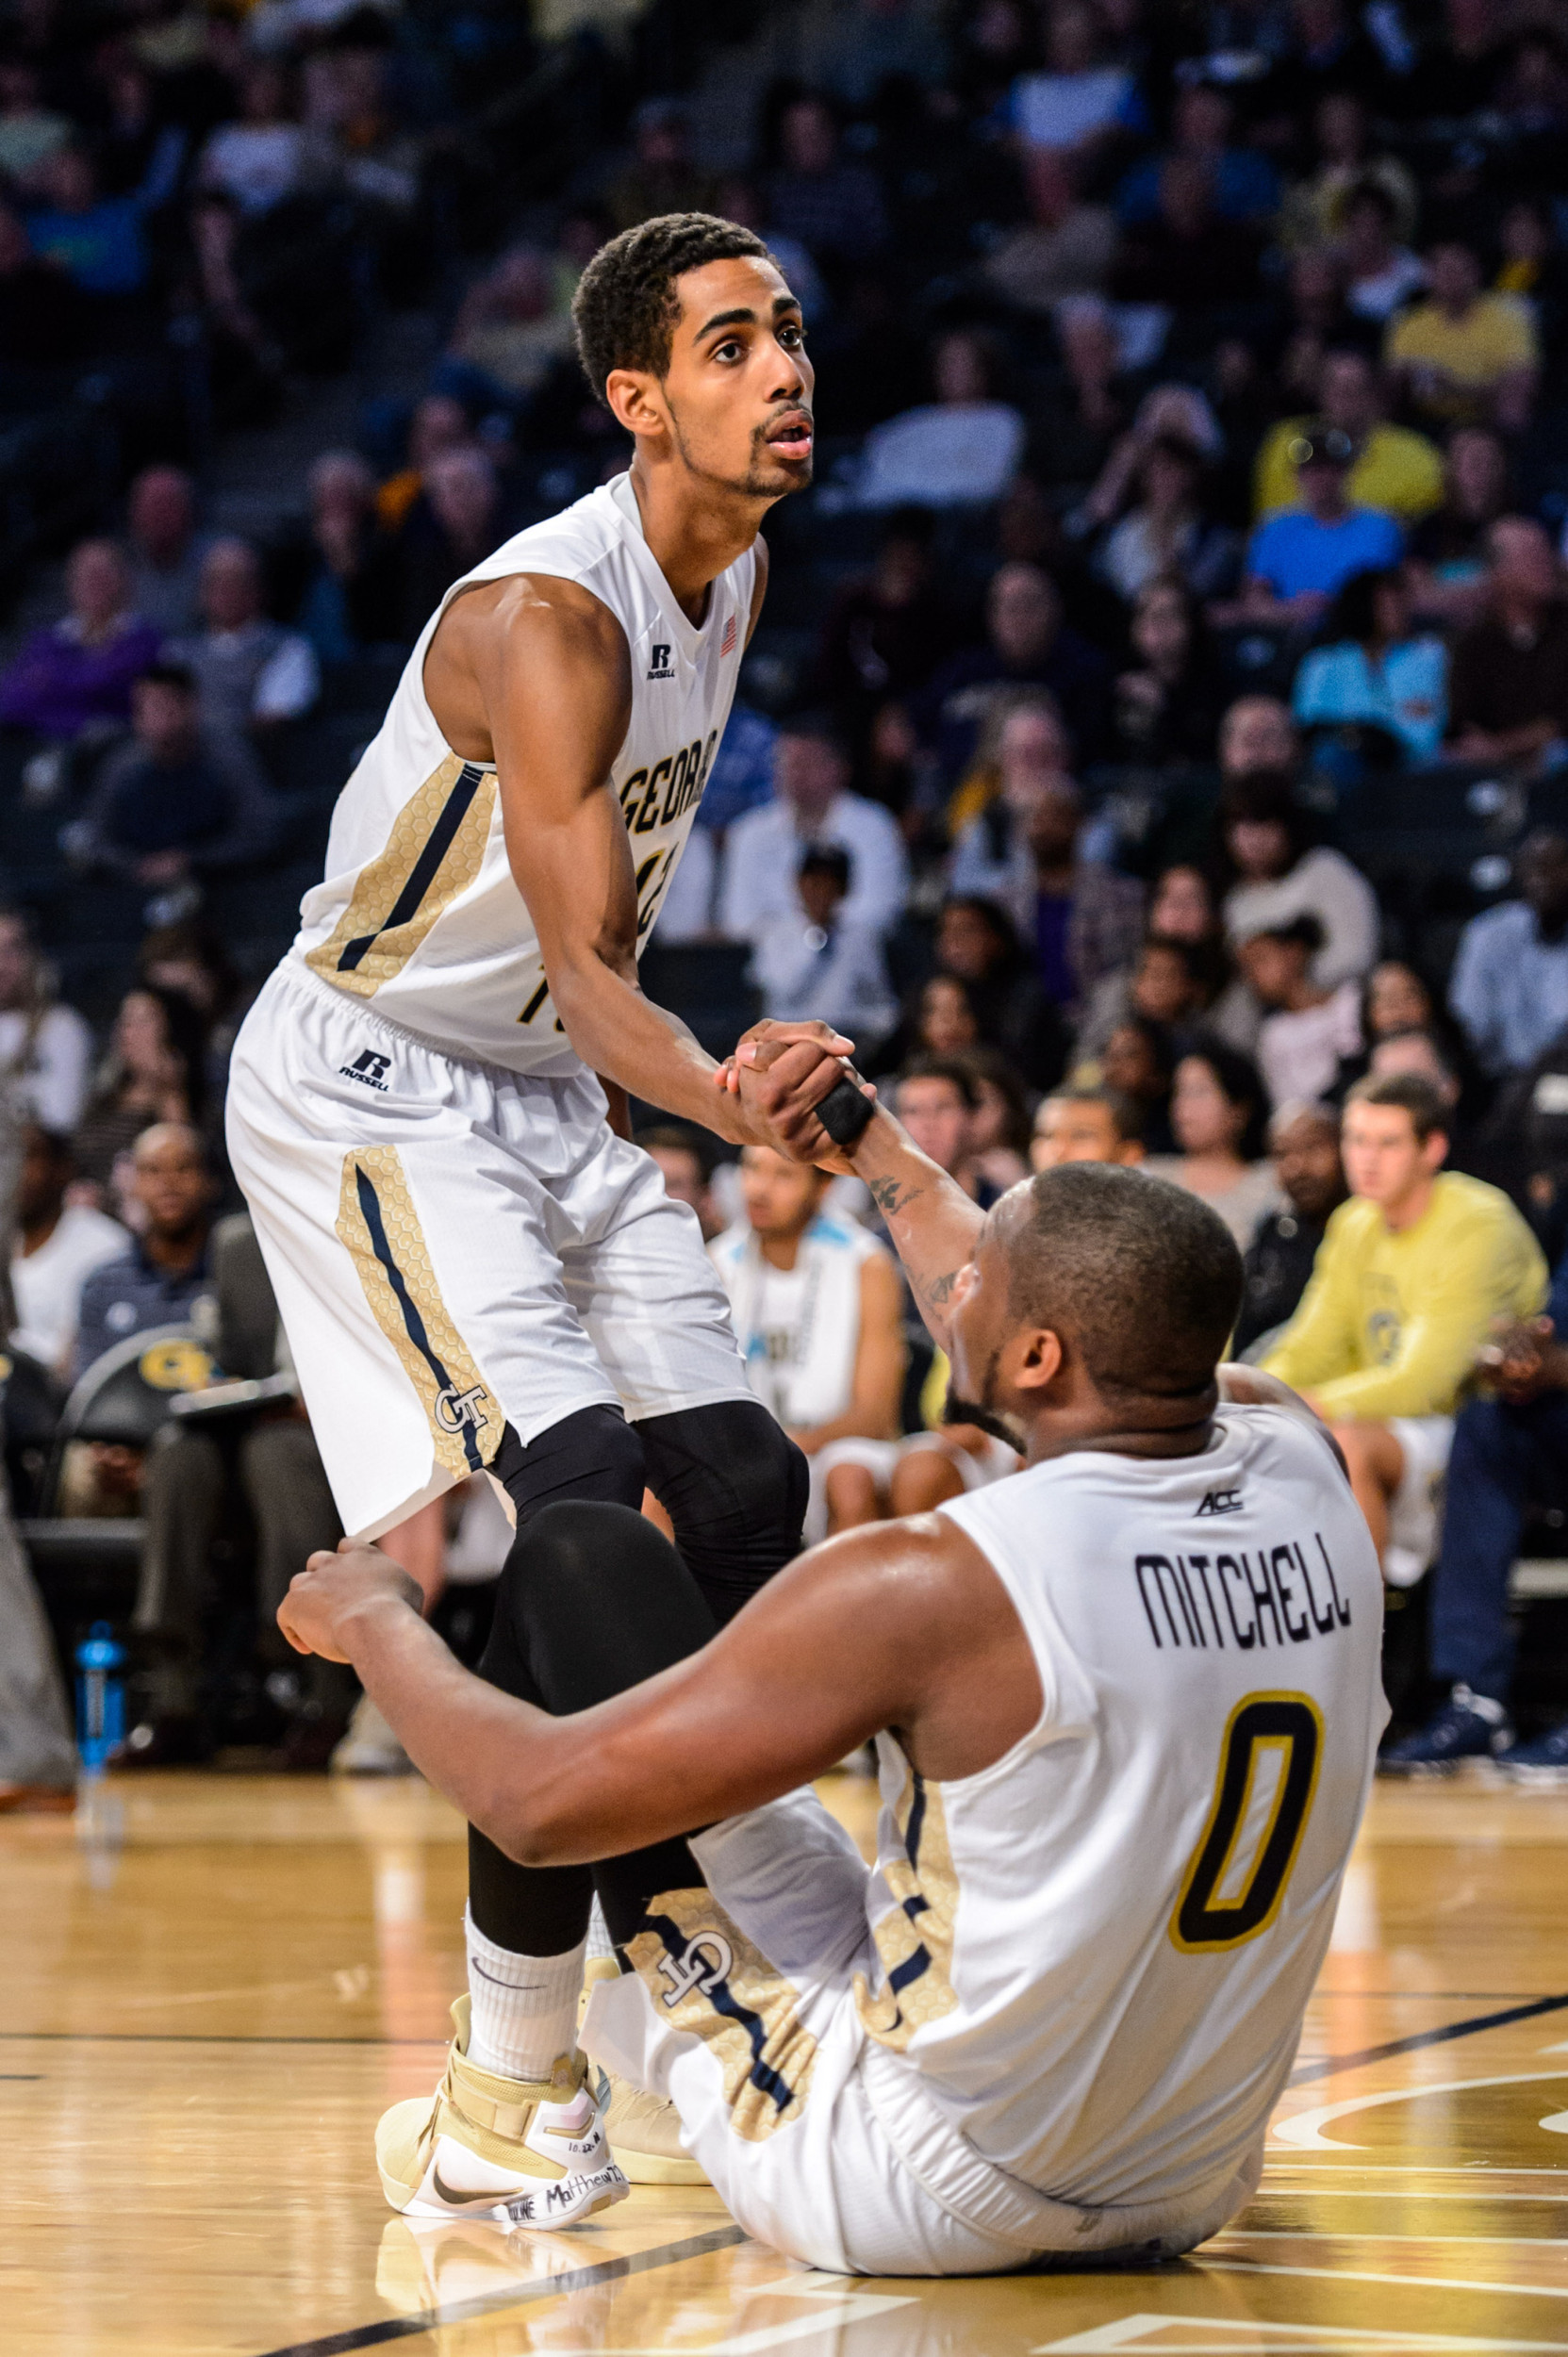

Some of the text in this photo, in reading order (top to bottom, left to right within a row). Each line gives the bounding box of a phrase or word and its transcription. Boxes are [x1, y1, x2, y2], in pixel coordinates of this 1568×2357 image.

[652, 644, 671, 669] R
[338, 1065, 389, 1092] RUSSELL
[352, 1048, 391, 1080] R
[1193, 1489, 1245, 1517] ACC
[1134, 1531, 1352, 1650] MITCHELL
[1167, 1689, 1326, 1955] 0
